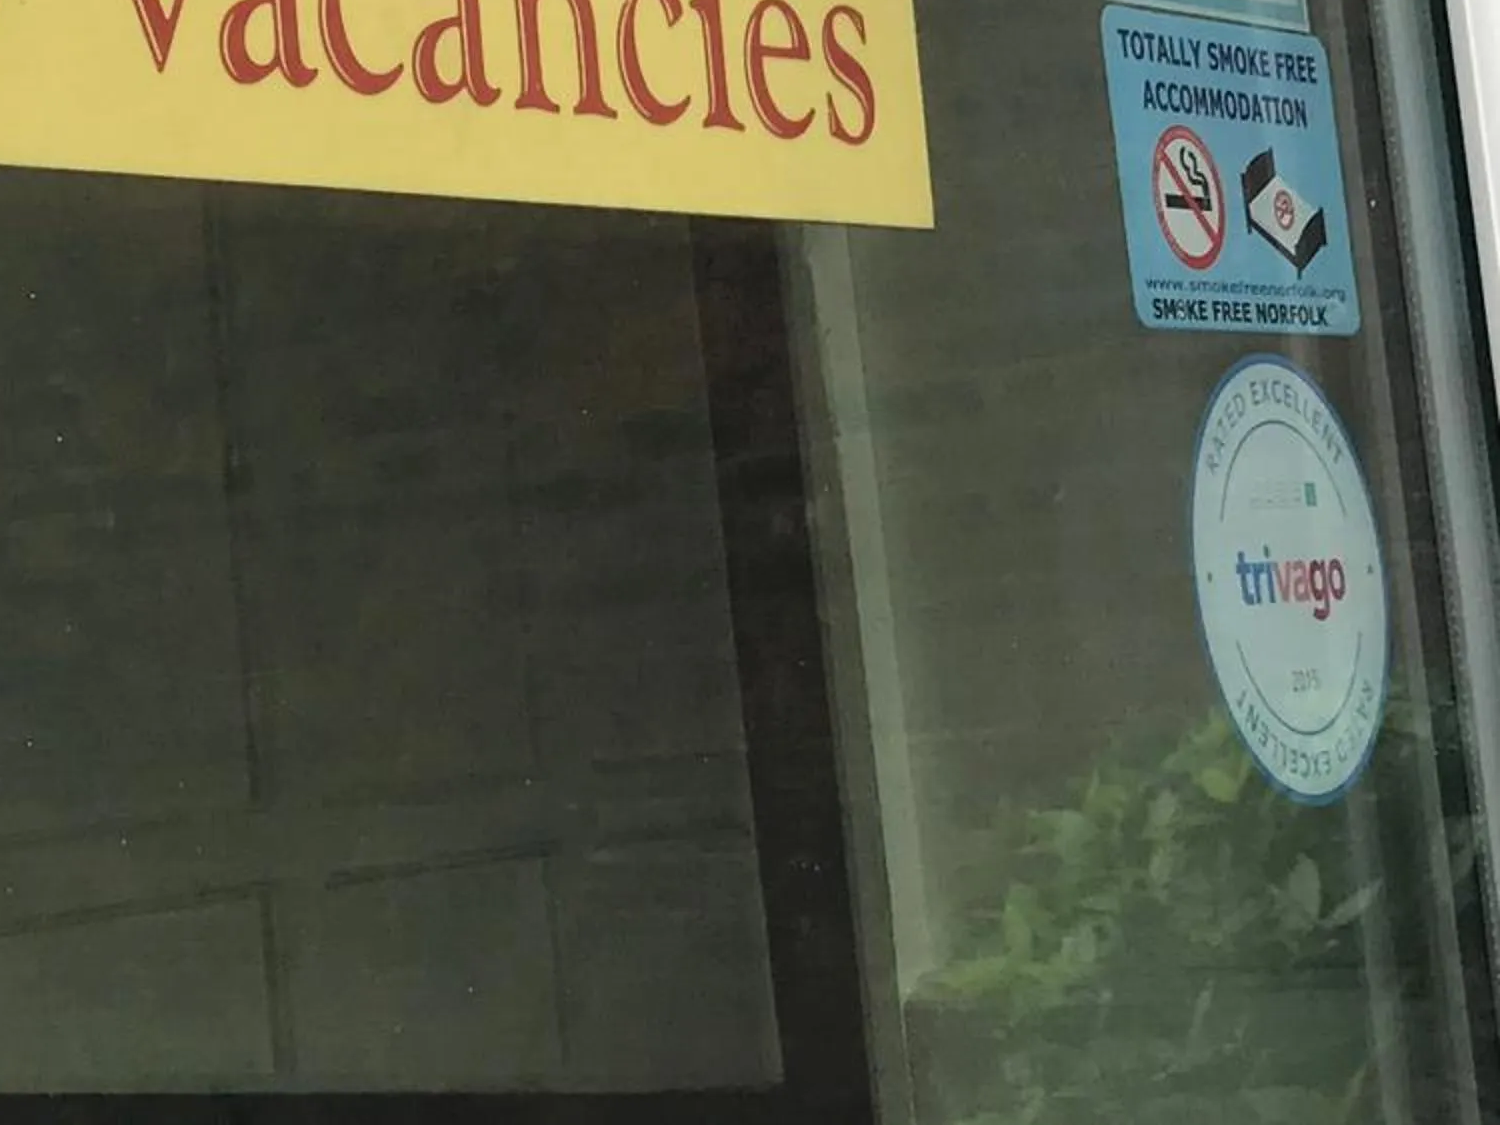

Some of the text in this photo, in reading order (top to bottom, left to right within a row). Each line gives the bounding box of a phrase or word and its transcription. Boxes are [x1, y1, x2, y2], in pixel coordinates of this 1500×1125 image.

[1117, 28, 1318, 85] TOTALLY SMOKE FREE
[1143, 78, 1309, 129] ACCOMMODATION
[1153, 298, 1329, 327] SMOKE FREE NORFOLK
[1206, 379, 1343, 476] RATED EXCELLENT
[1236, 546, 1347, 621] trivago
